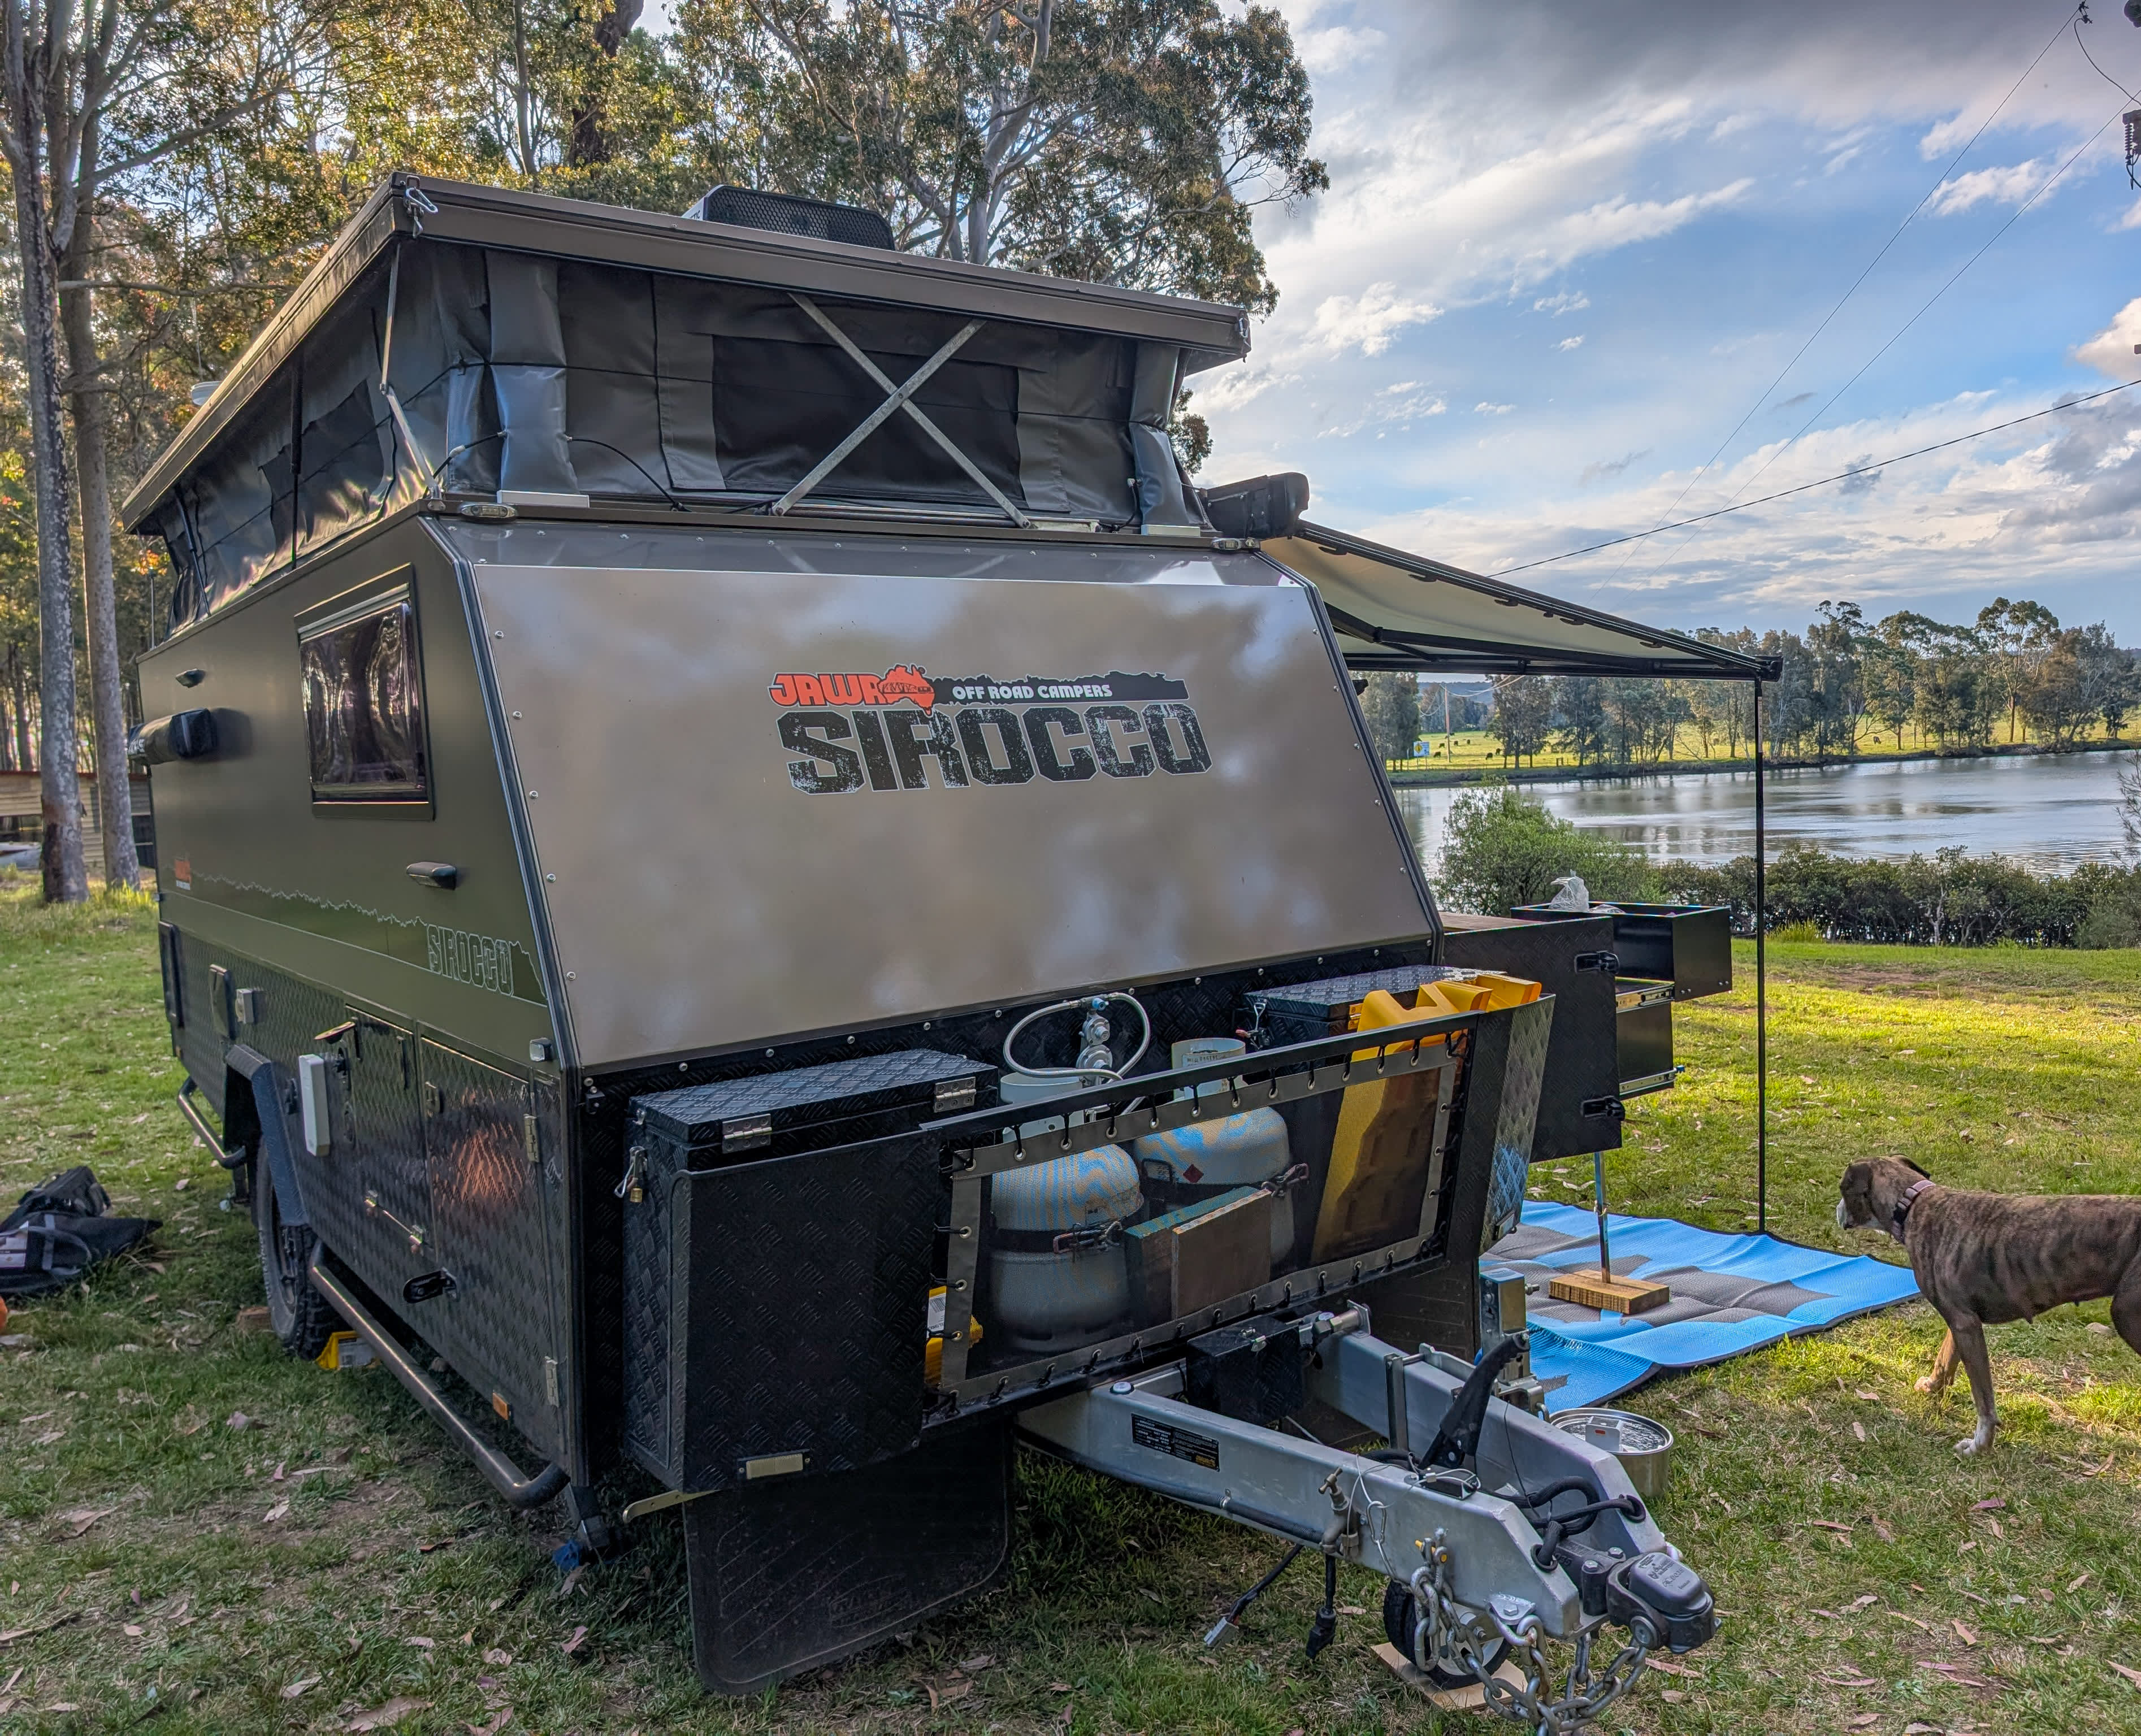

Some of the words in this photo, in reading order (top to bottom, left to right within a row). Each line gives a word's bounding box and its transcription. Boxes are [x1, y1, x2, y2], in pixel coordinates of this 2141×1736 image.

[952, 685, 985, 700] OFF
[987, 685, 1034, 699] ROAD
[1037, 684, 1113, 699] CAMPERS
[776, 703, 1213, 795] SIROCCO
[427, 923, 514, 996] SIROCCO
